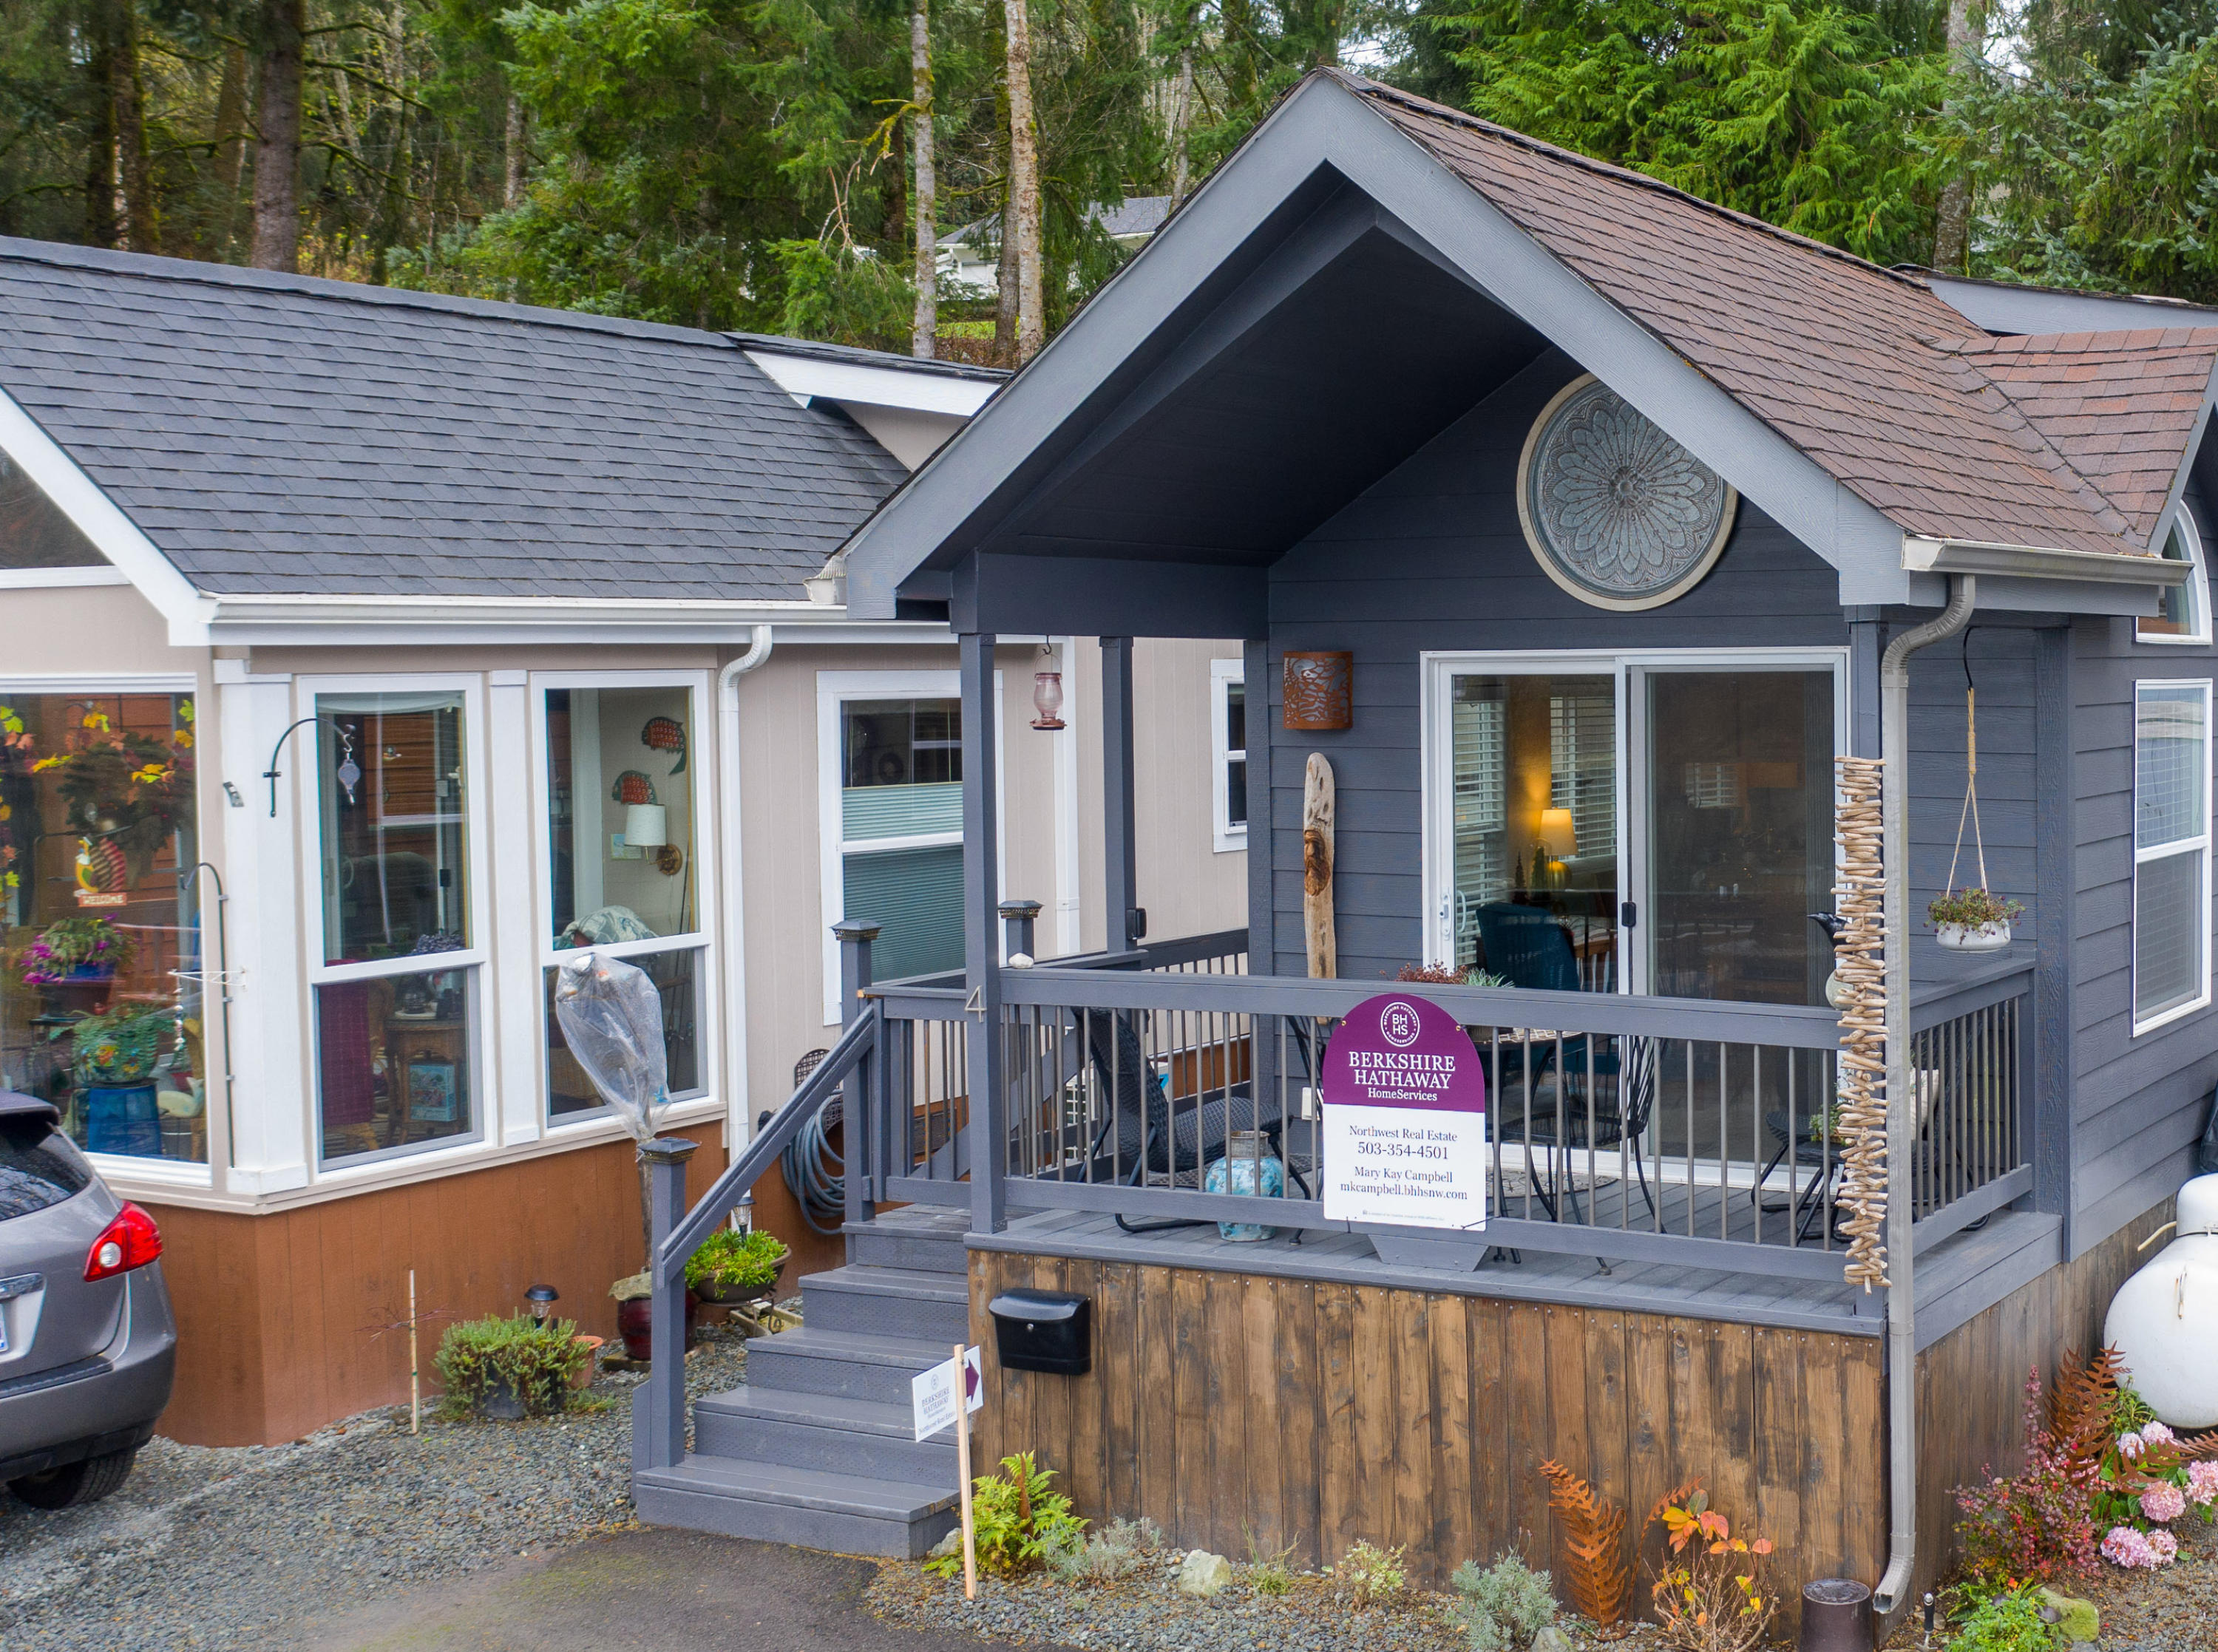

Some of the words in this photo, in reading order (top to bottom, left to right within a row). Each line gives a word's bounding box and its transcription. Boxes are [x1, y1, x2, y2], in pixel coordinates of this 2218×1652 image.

[82, 894, 123, 905] WELCOME
[964, 985, 987, 1023] 4
[1392, 1013, 1408, 1024] BH
[1393, 1024, 1408, 1036] HS
[1349, 1051, 1456, 1072] BERKSHIRE
[1354, 1069, 1452, 1089] HATHAWAY
[1368, 1087, 1438, 1101] HomeServices
[1349, 1124, 1399, 1138] Northwest
[1403, 1128, 1424, 1140] Real
[1428, 1129, 1458, 1142] Estate
[1357, 1141, 1448, 1160] 503-354-4501
[1354, 1166, 1380, 1180] Mary
[1383, 1168, 1402, 1182] Kay
[1405, 1169, 1454, 1184] Campbell
[1340, 1180, 1468, 1200] mkcampbell.bhhsnw.com
